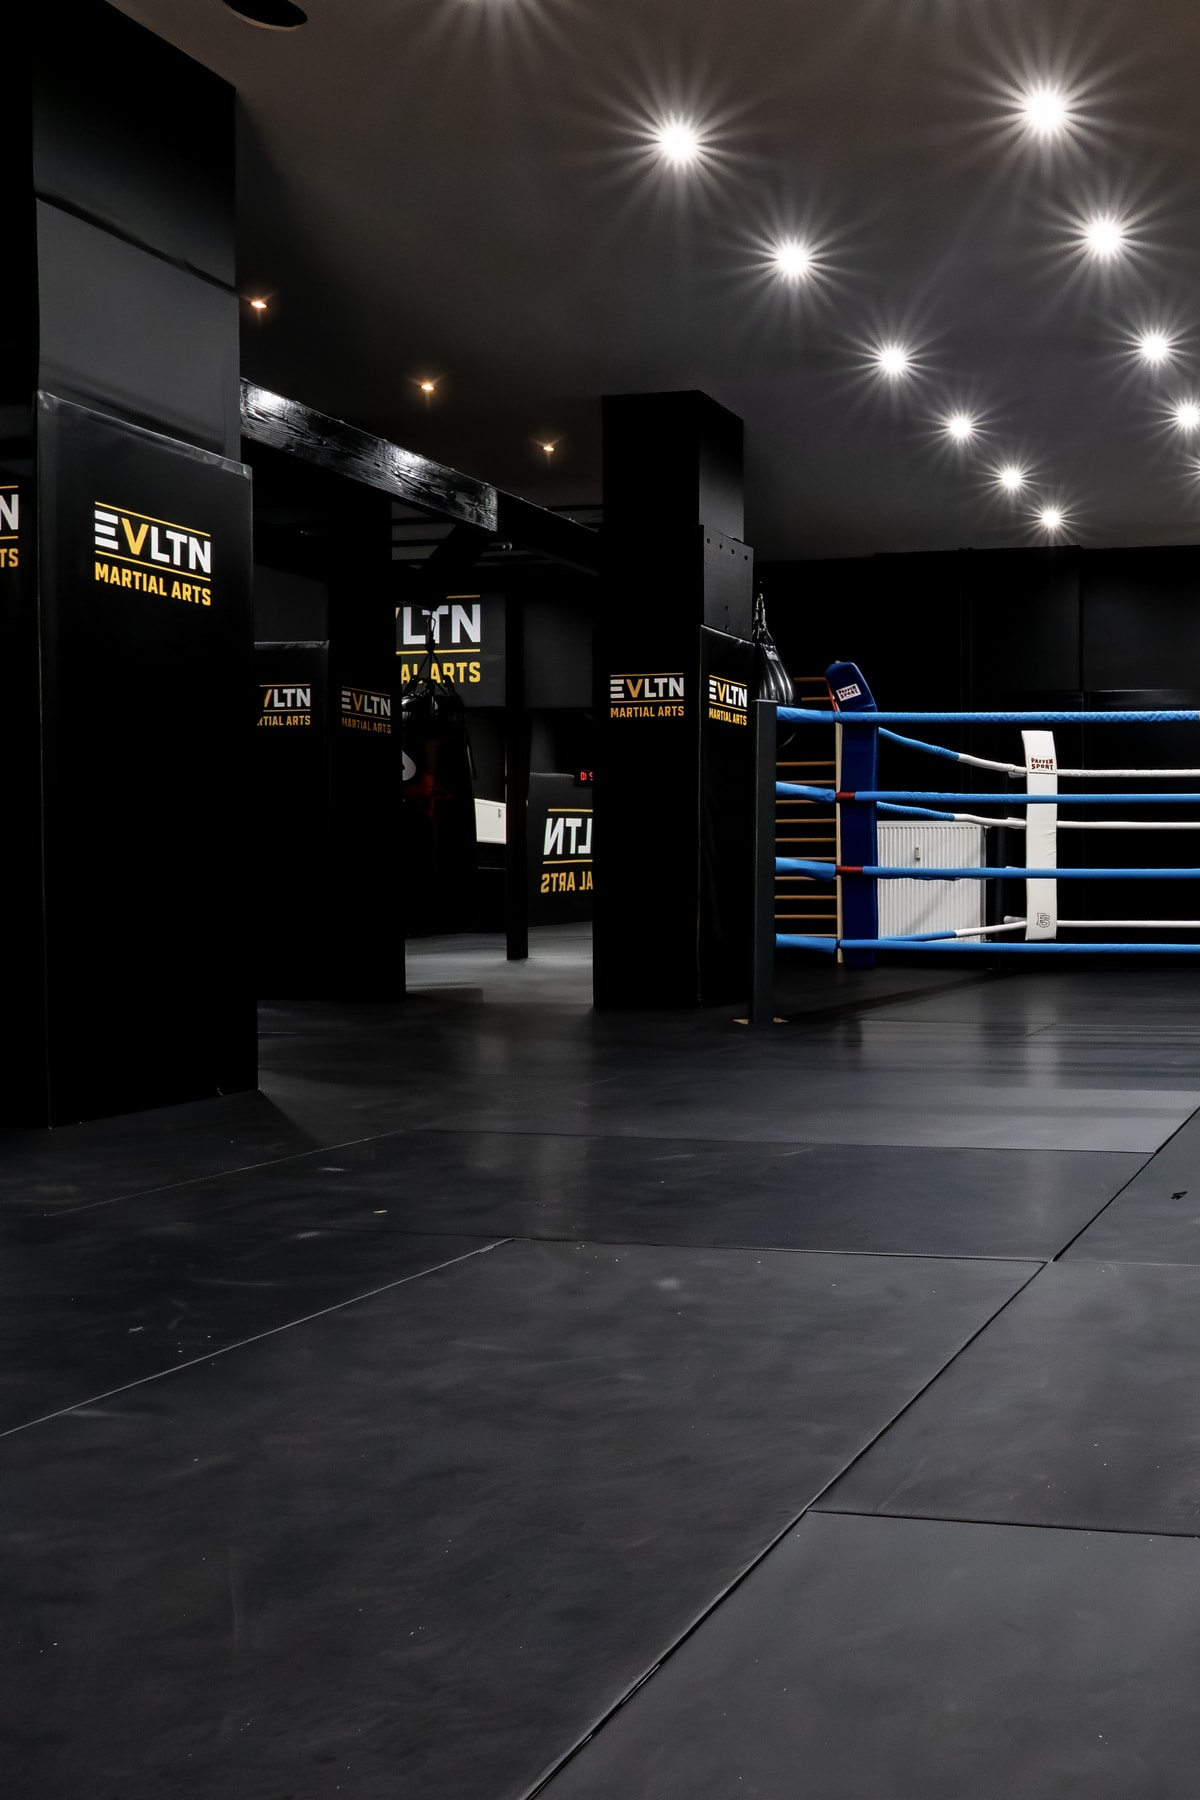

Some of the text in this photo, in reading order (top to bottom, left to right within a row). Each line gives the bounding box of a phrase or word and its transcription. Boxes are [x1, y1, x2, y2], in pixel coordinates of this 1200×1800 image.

[95, 510, 211, 573] EVLTN
[95, 562, 211, 605] MARTIAL ARTS
[395, 603, 481, 645] LTN
[430, 661, 481, 684] ARTS
[610, 677, 684, 698] EVLTN
[709, 679, 747, 707] EVLTN
[341, 690, 391, 717] EVLTN
[610, 705, 684, 718] MARTIAL ARTS
[286, 715, 311, 726] ARTS
[341, 717, 392, 734] MARTIAL ARTS
[708, 707, 748, 726] MARTIAL ARTS
[1031, 763, 1053, 771] SPORT
